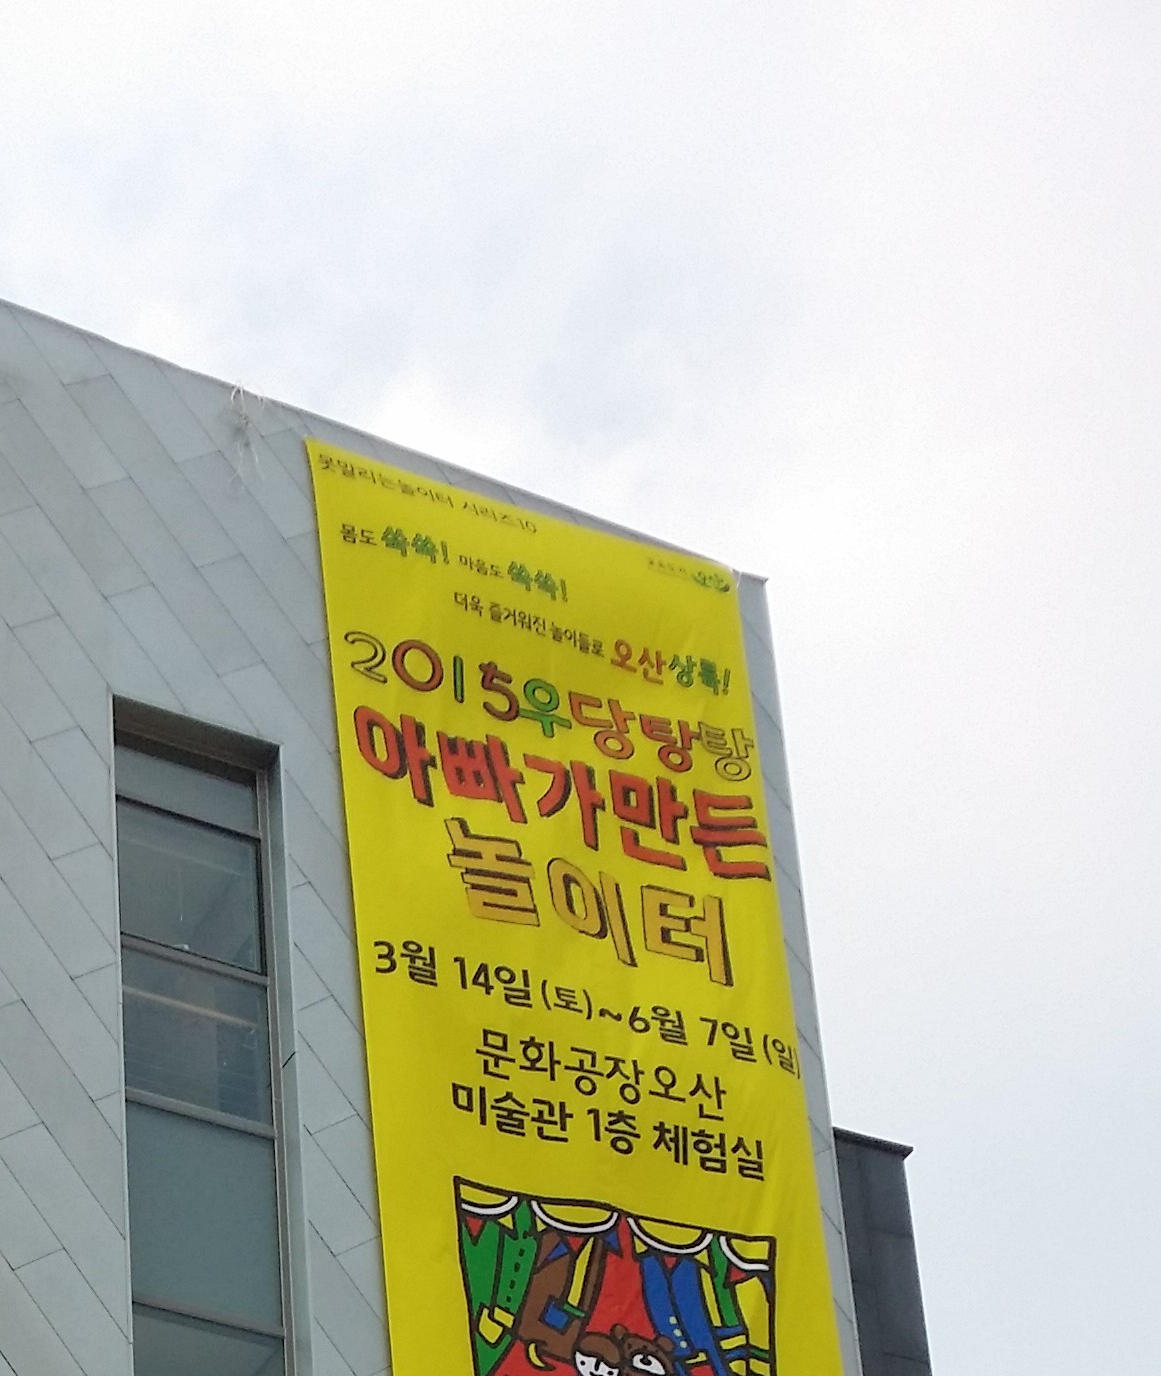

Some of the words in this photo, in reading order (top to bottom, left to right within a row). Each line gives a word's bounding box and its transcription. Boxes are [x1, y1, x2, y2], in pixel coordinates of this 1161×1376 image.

[340, 523, 377, 546] 몸도
[458, 555, 504, 579] 마음도
[454, 591, 484, 618] 더욱
[489, 602, 546, 637] 즐거워진
[444, 816, 734, 987] 놀이터
[373, 940, 438, 987] 3월
[475, 1028, 727, 1122] 문화공장오산
[451, 1082, 574, 1138] 미술관
[587, 1108, 642, 1156] 1층
[652, 1120, 765, 1182] 체험실
